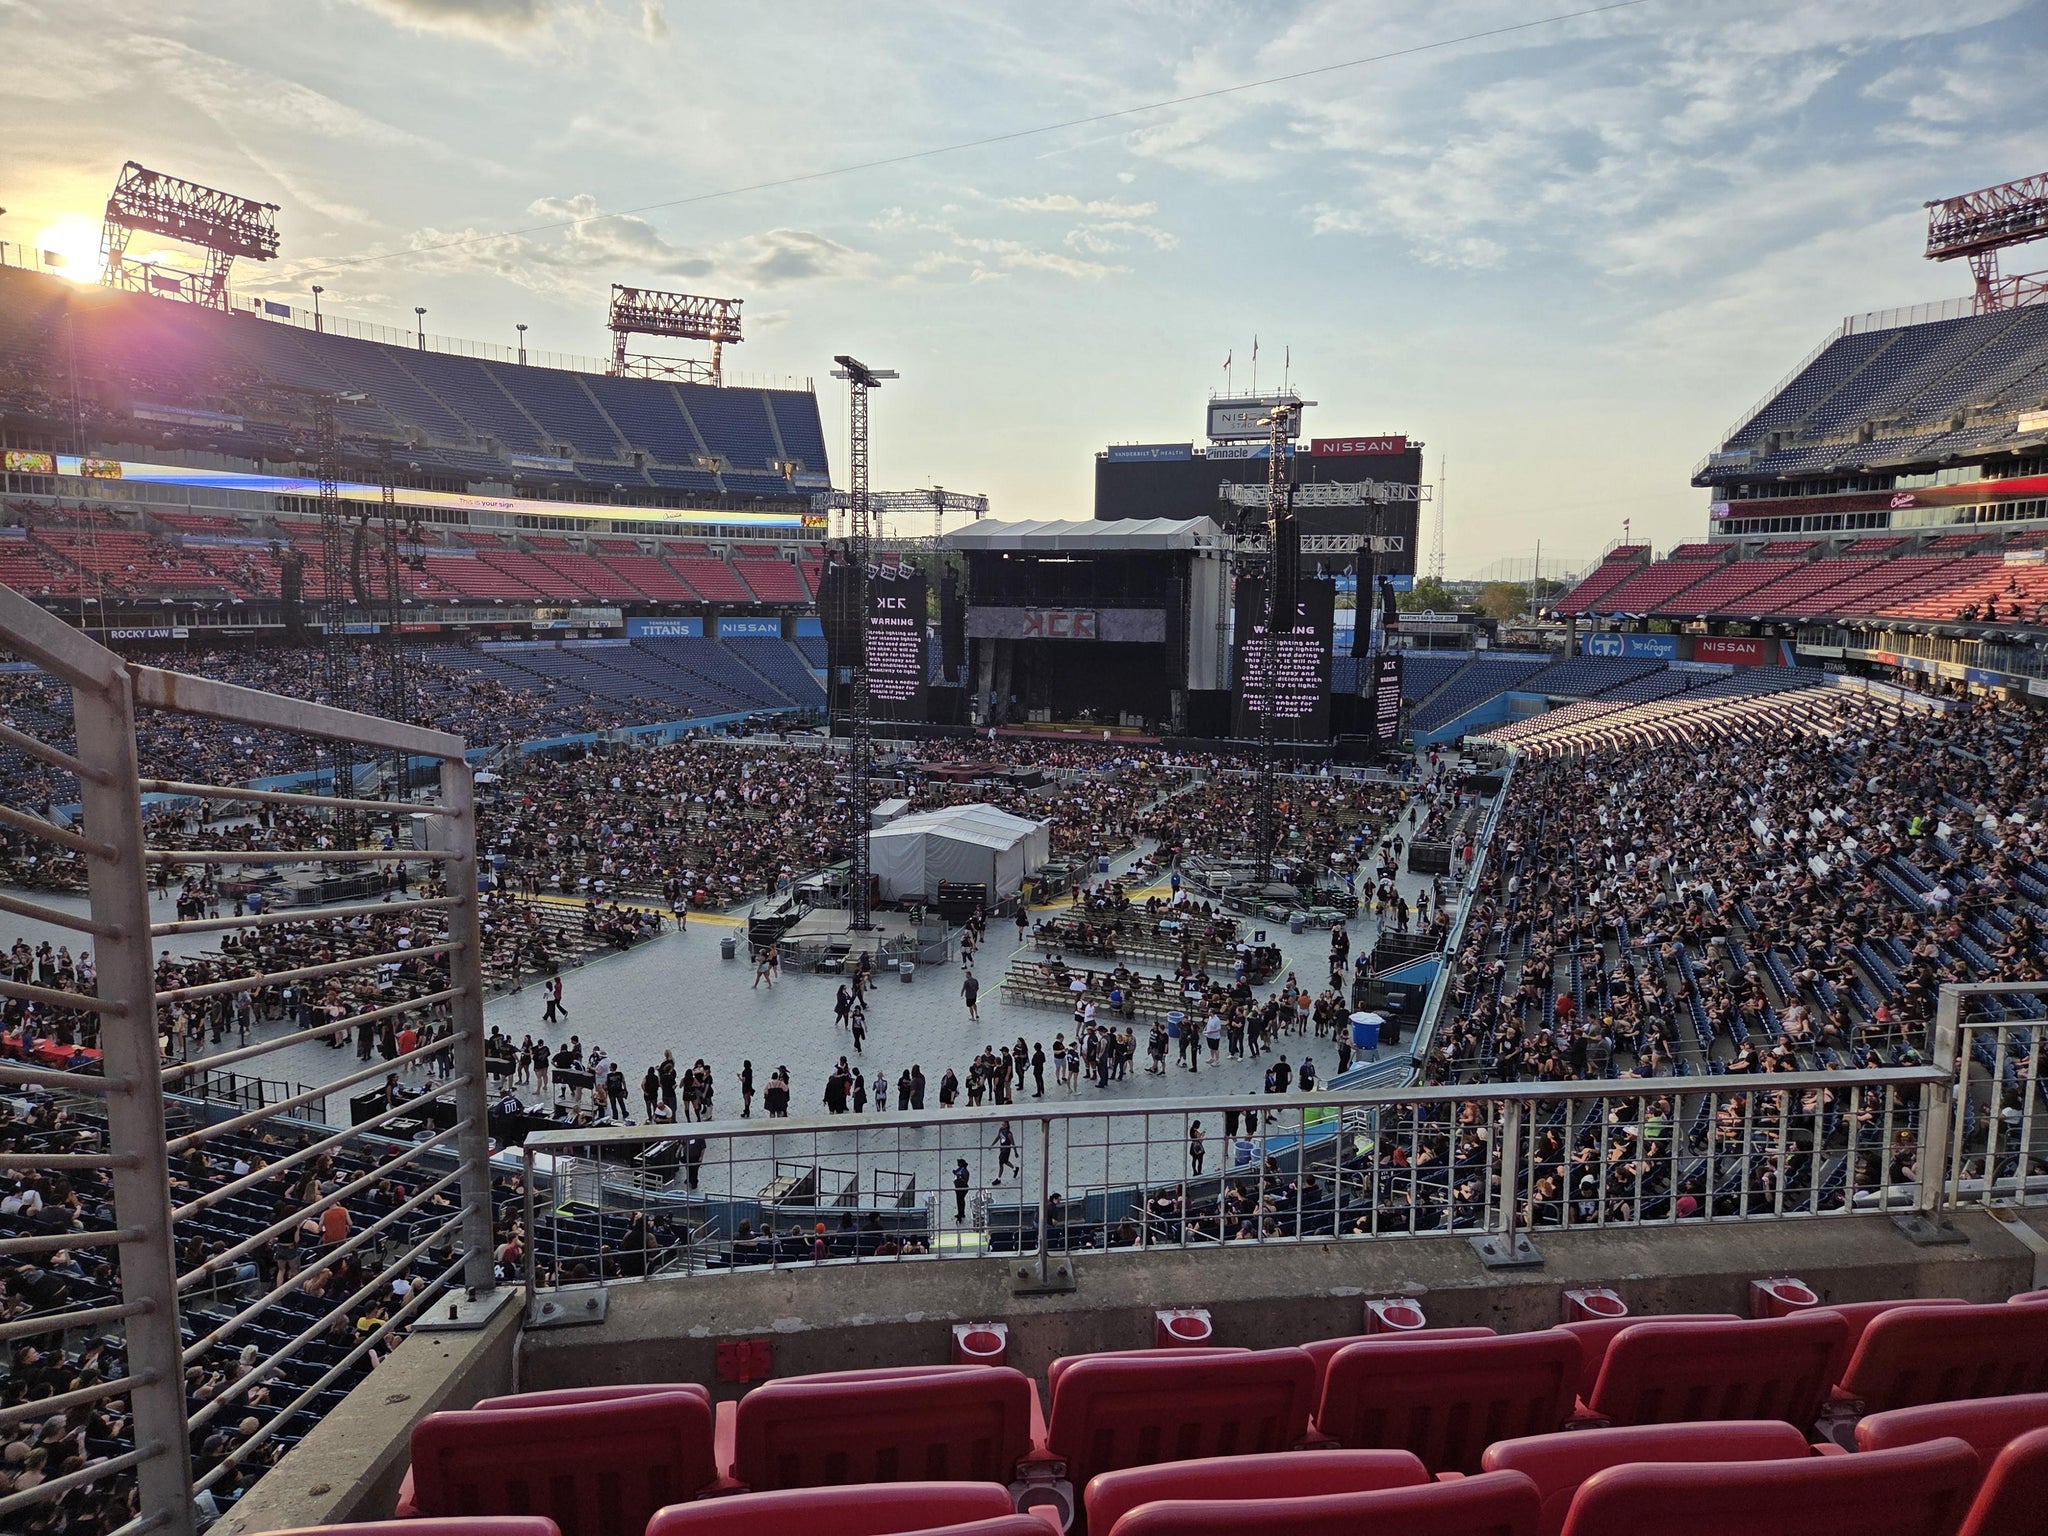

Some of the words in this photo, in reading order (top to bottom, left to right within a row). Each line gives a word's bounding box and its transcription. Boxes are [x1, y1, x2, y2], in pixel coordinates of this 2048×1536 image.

[1323, 441, 1393, 453] NISSAN
[1207, 448, 1248, 459] Pinnacle
[499, 501, 514, 509] sign
[870, 617, 914, 626] WARNING
[641, 625, 689, 635] TITANS
[722, 624, 777, 632] NISSAN
[1253, 626, 1315, 635] WING
[111, 629, 146, 639] ROCKY
[148, 628, 169, 638] LAW
[1643, 639, 1672, 657] Kroger
[1703, 642, 1756, 653] NISSAN
[1823, 662, 1847, 673] TITANS
[382, 972, 390, 982] M
